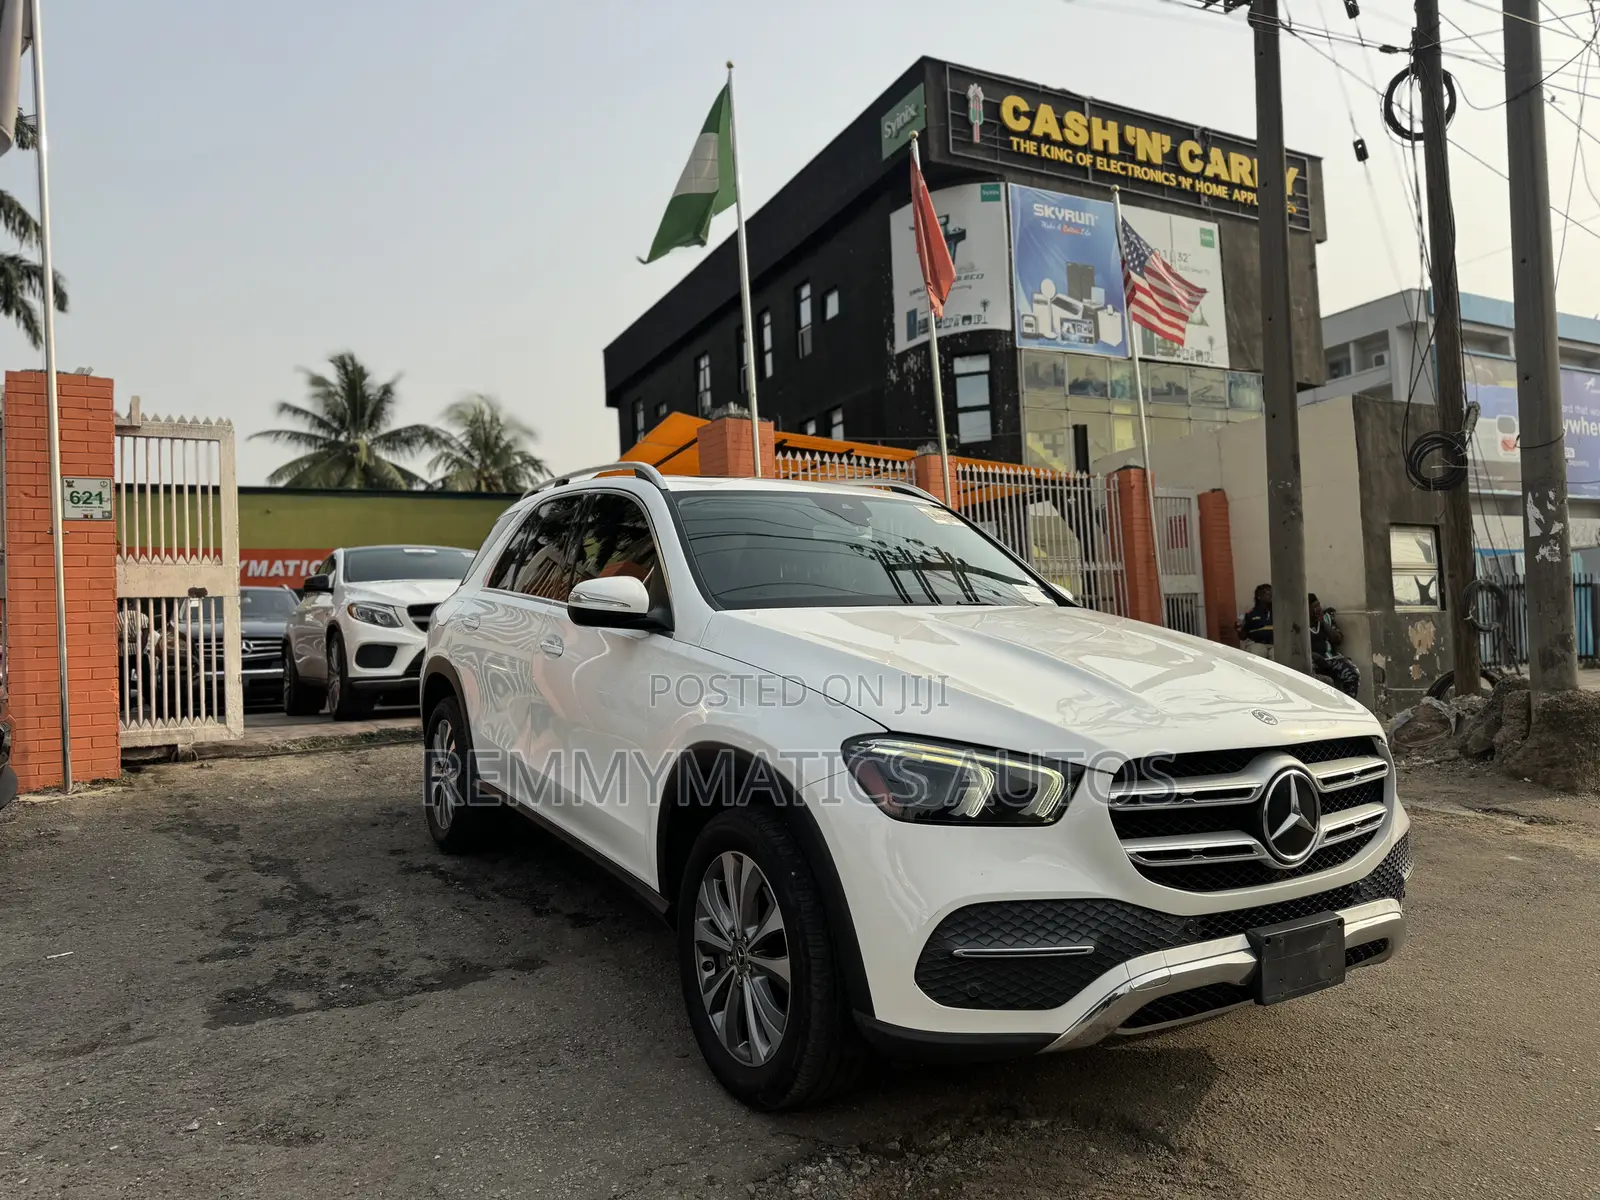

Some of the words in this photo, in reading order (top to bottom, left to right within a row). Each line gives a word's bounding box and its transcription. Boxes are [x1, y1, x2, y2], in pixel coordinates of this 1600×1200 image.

[1001, 95, 1119, 155] CASH
[1178, 140, 1299, 196] CARY
[1009, 136, 1038, 155] THE
[1041, 143, 1073, 163] KING
[1076, 152, 1093, 167] OF
[1096, 157, 1176, 186] ELECTRONICS
[1196, 179, 1228, 199] HOME
[70, 491, 103, 505] 621
